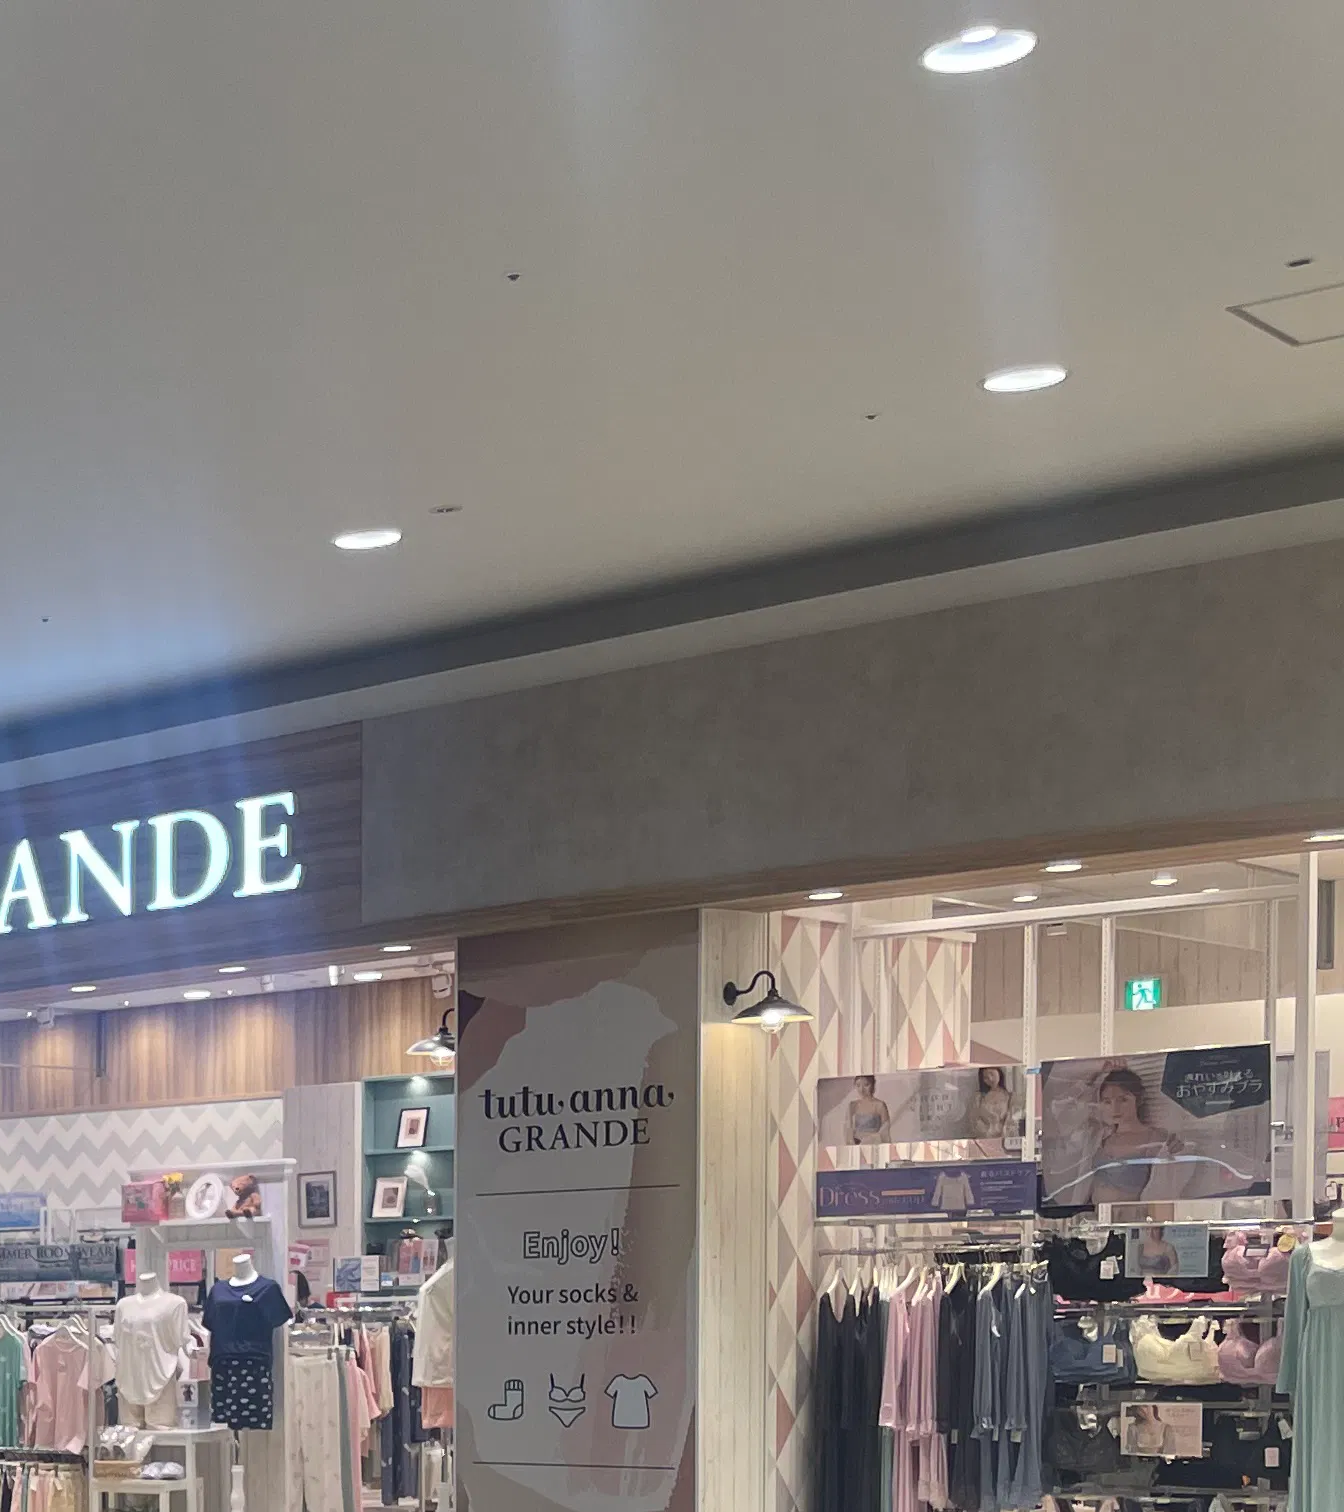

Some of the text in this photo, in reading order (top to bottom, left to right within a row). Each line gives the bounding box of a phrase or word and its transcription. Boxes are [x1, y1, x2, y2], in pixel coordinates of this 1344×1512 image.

[499, 1118, 651, 1152] GRANDE
[523, 1228, 620, 1264] Enjoy!
[508, 1283, 638, 1304] Your socks &
[507, 1316, 561, 1335] inner
